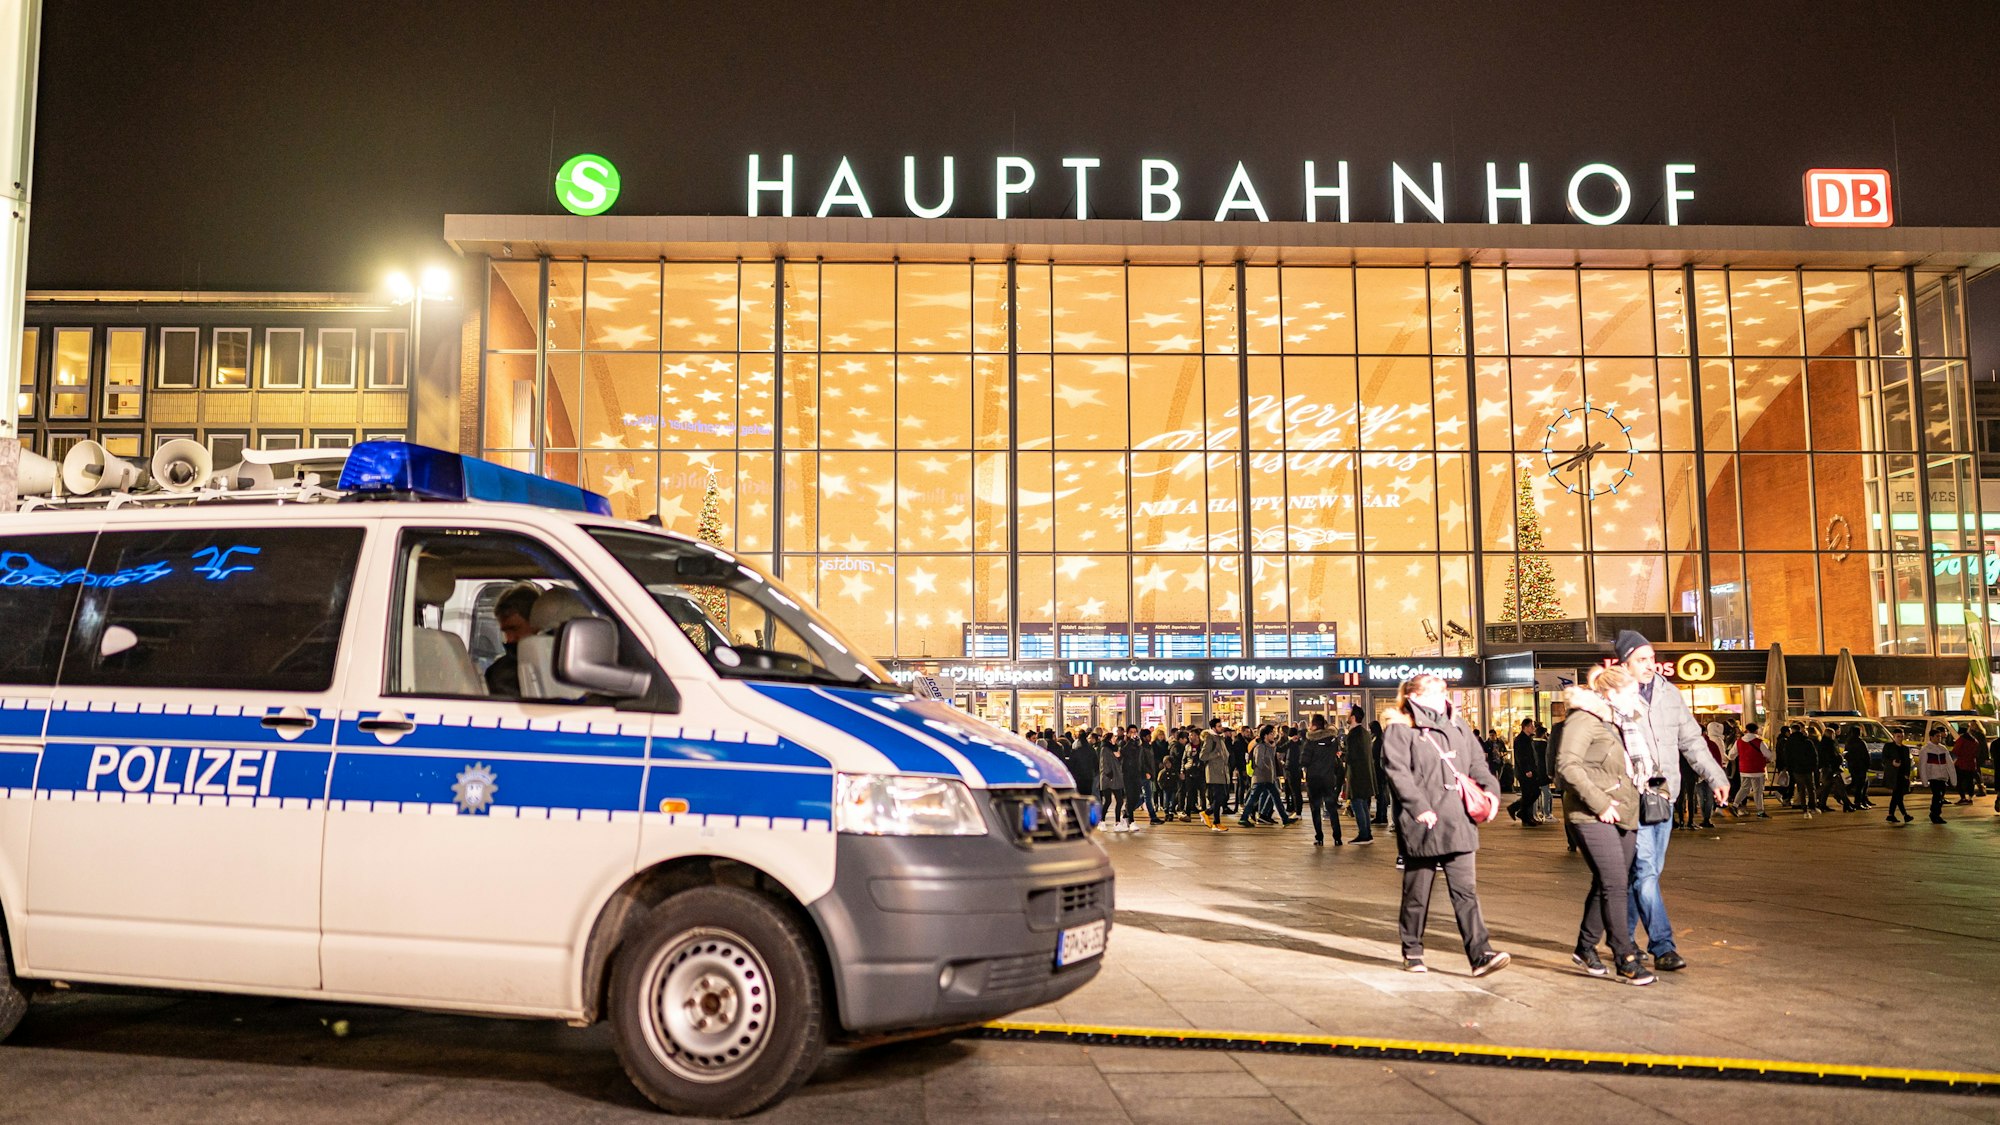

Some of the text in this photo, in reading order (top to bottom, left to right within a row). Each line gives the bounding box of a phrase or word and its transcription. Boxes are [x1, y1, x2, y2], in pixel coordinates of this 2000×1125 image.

[564, 159, 610, 212] S
[746, 153, 1697, 226] HAUPTBAHNHOF
[1816, 178, 1882, 218] DB
[1223, 394, 1400, 439] Merry
[1117, 426, 1431, 478] Chistmas
[1207, 496, 1284, 513] HAPPY
[1288, 494, 1338, 510] NEW
[1342, 493, 1401, 509] YEAR
[967, 667, 1054, 685] Highspeed
[1098, 665, 1195, 684] NetCologne
[1239, 665, 1324, 684] Highspeed
[86, 745, 277, 797] POLIZEI
